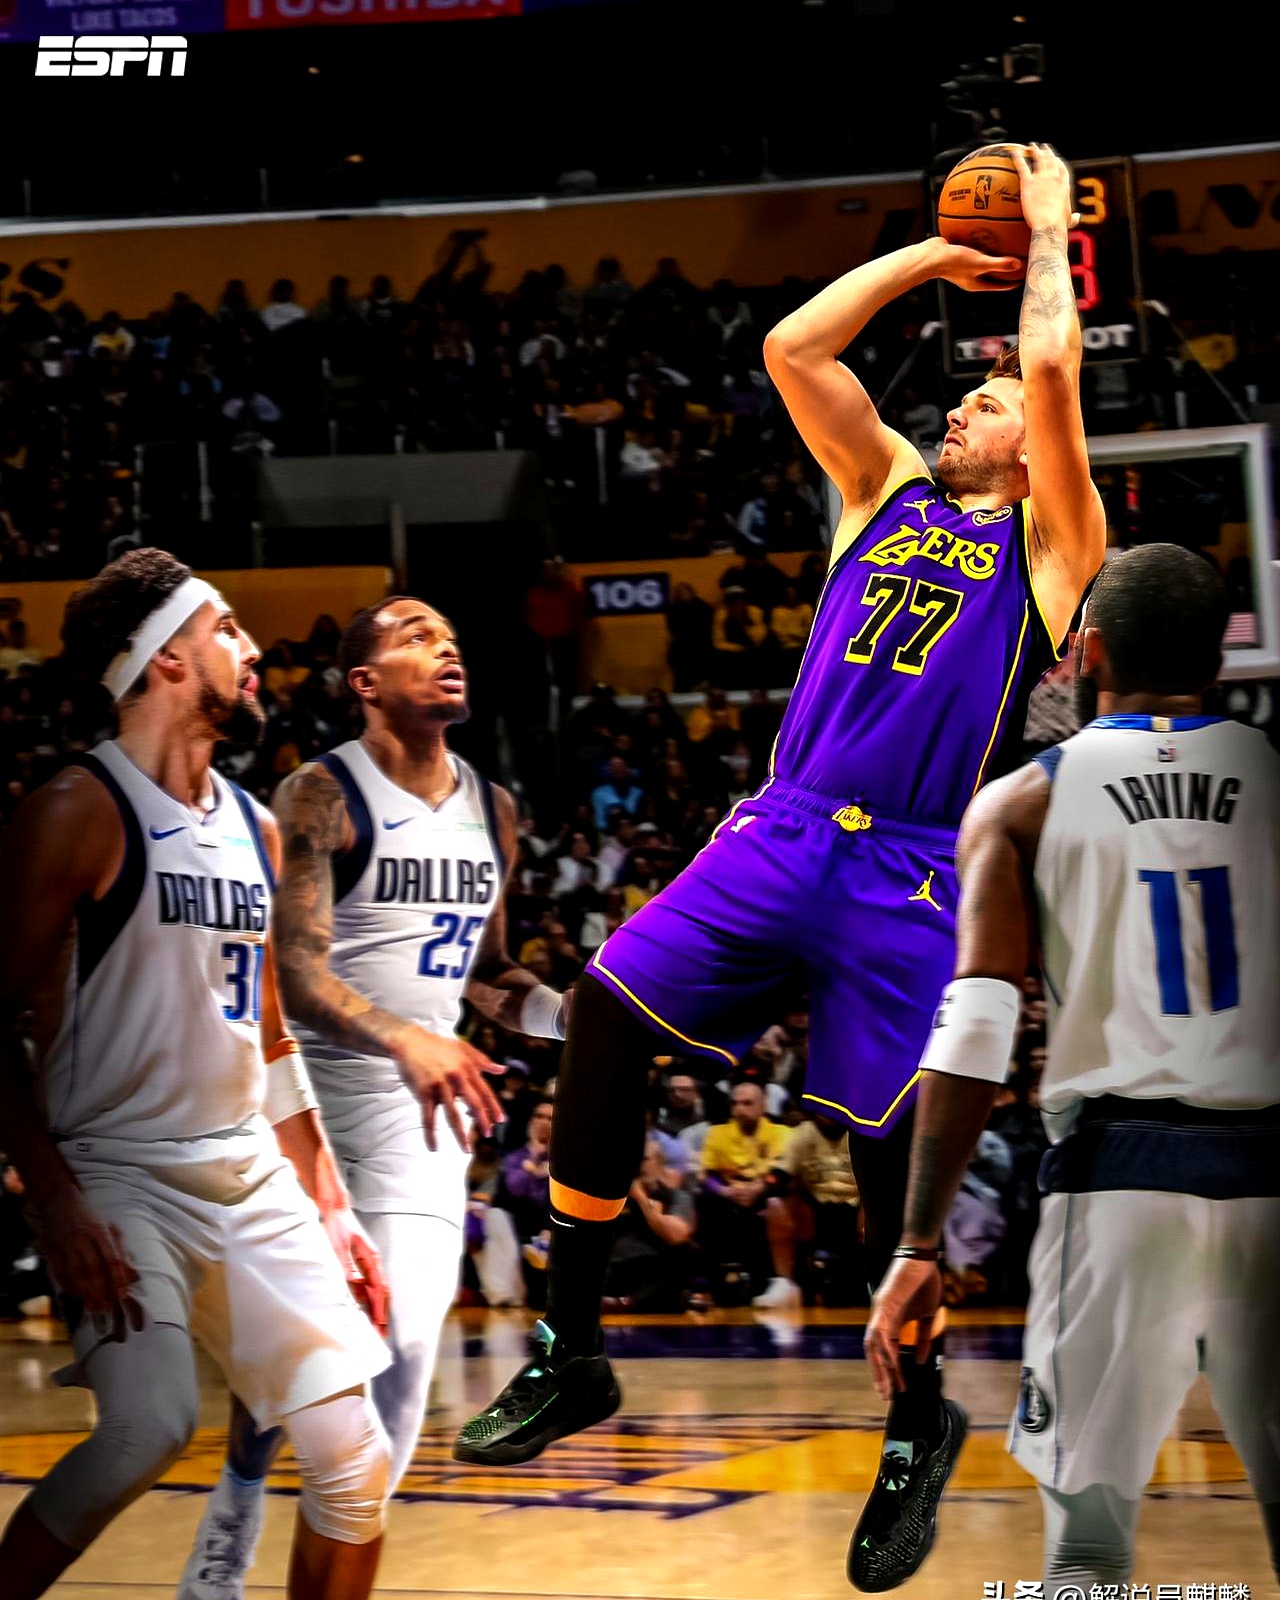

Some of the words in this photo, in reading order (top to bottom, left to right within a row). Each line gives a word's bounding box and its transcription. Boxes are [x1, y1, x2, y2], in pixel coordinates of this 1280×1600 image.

[858, 524, 1000, 580] LAERS
[590, 579, 662, 609] 106
[843, 572, 965, 676] 77
[1101, 772, 1242, 825] IRVING
[155, 871, 267, 932] DALLAS
[374, 857, 494, 904] DALLAS
[417, 911, 485, 979] 25
[1137, 866, 1240, 1018] 11
[221, 941, 264, 1021] 31
